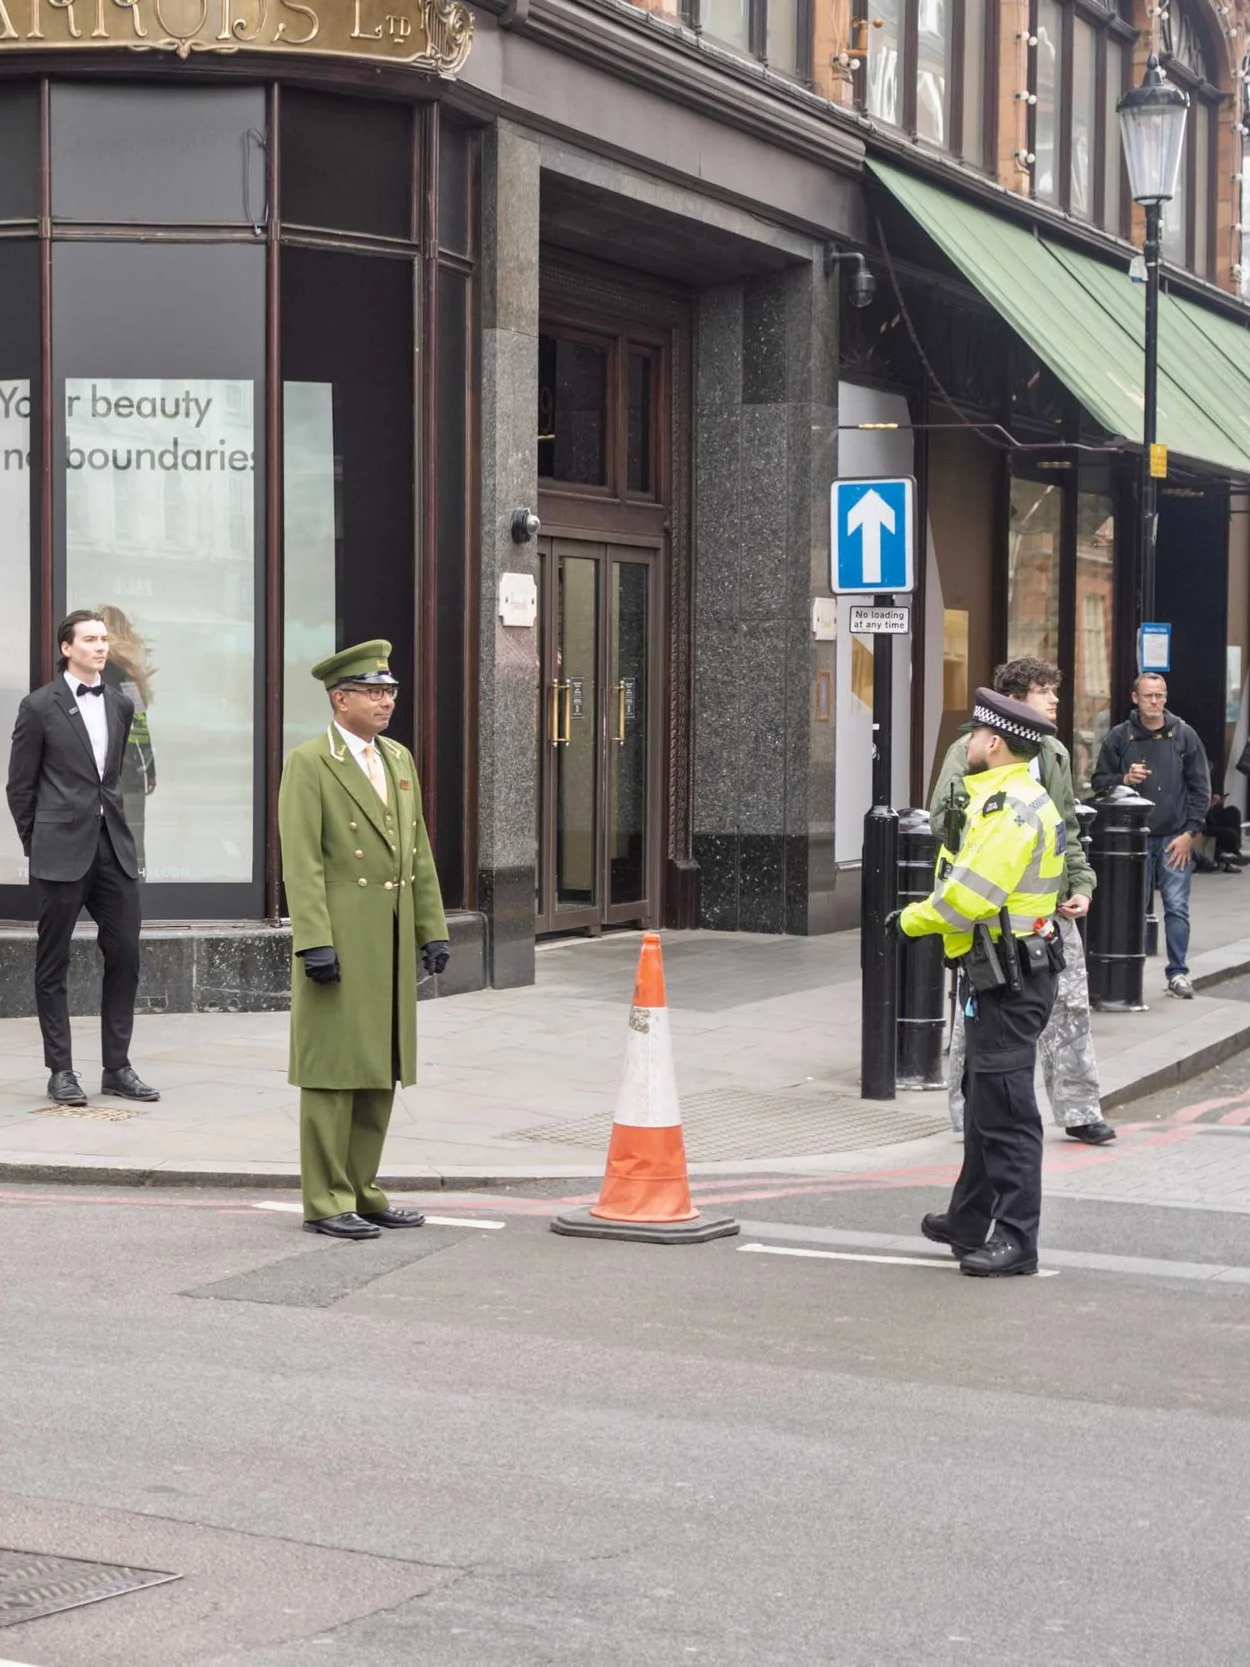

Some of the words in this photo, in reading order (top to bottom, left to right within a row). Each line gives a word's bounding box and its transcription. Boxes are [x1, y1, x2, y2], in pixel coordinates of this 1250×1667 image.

[91, 383, 213, 428] beauty
[3, 448, 31, 471] n
[66, 436, 254, 472] boundarie
[854, 620, 863, 628] at
[865, 621, 882, 630] any
[885, 620, 905, 629] time
[855, 610, 869, 619] No
[871, 610, 905, 621] loading
